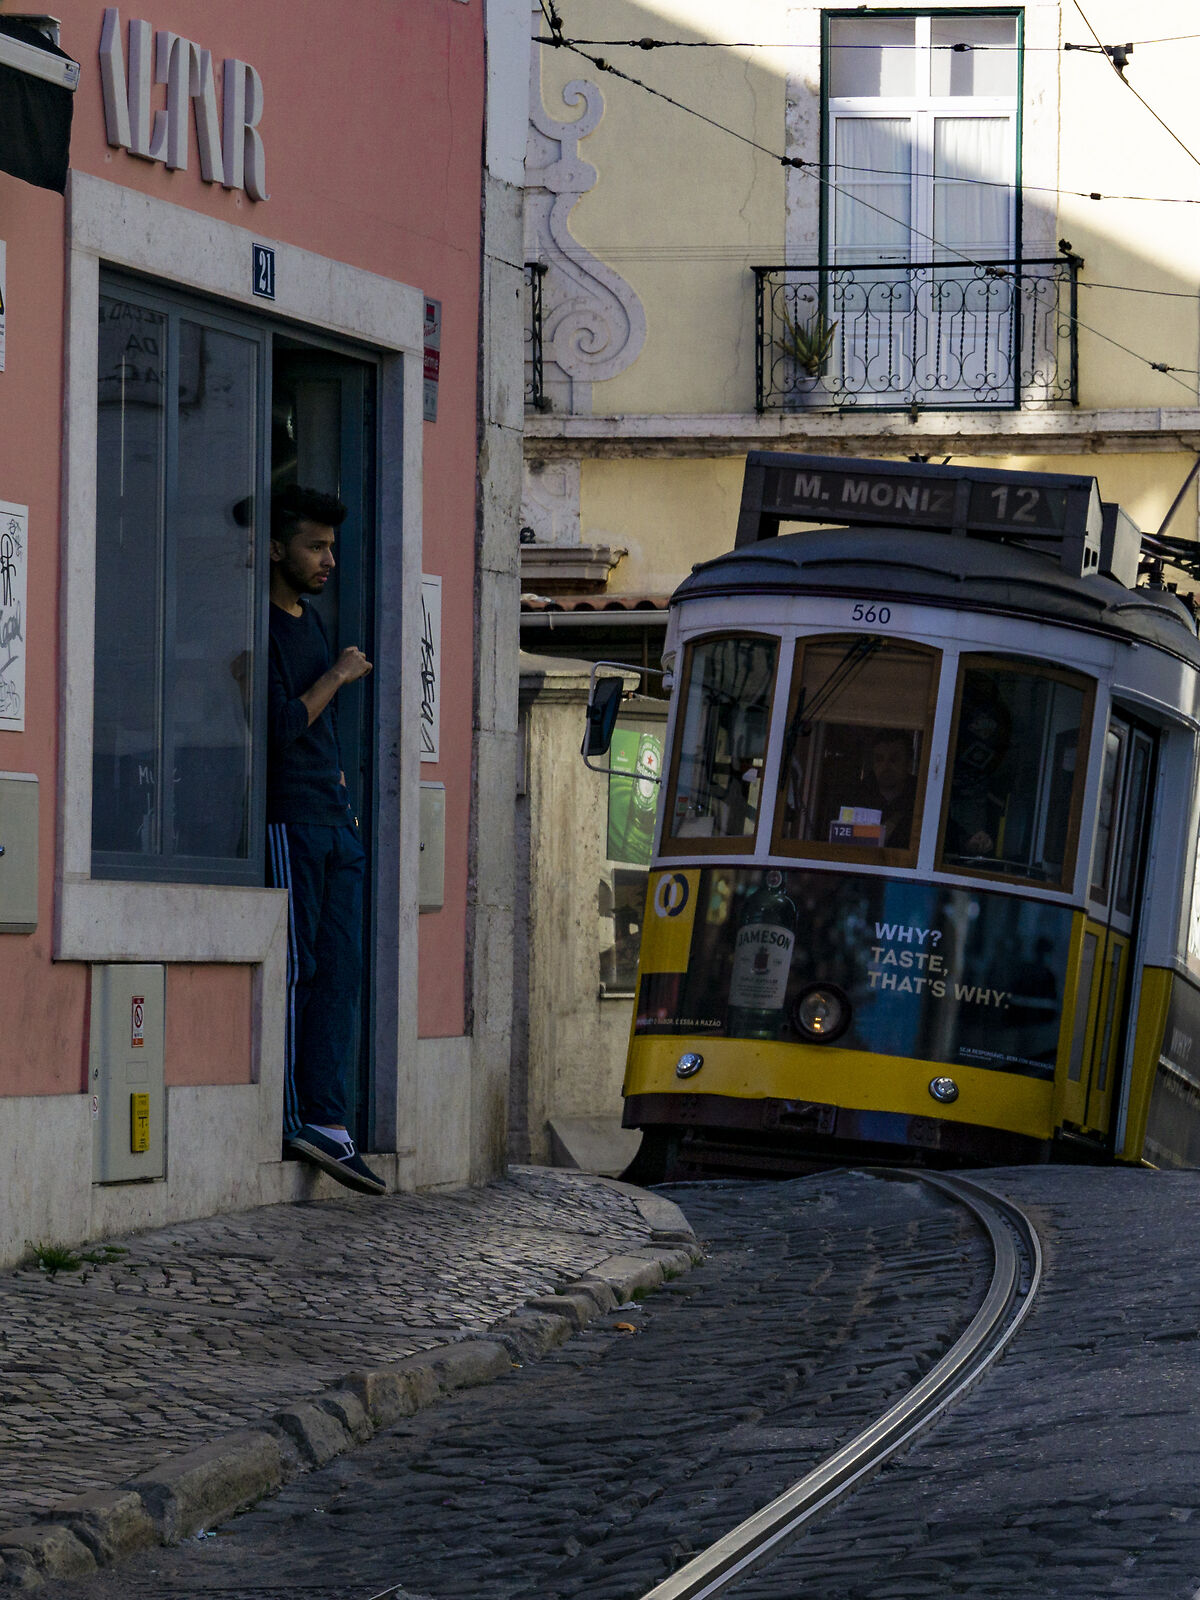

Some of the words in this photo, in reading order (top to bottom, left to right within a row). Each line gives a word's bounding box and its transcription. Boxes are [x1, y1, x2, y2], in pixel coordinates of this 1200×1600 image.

[99, 7, 271, 202] ALTAR
[258, 250, 274, 294] 21
[793, 473, 830, 501] M.
[841, 478, 955, 513] MONIZ
[991, 485, 1041, 523] 12
[851, 603, 892, 624] 560
[834, 826, 852, 837] 12E
[738, 929, 791, 951] JAMESON
[874, 921, 943, 948] WHY?
[870, 946, 949, 977] TASTE,
[867, 970, 947, 998] THAT'S
